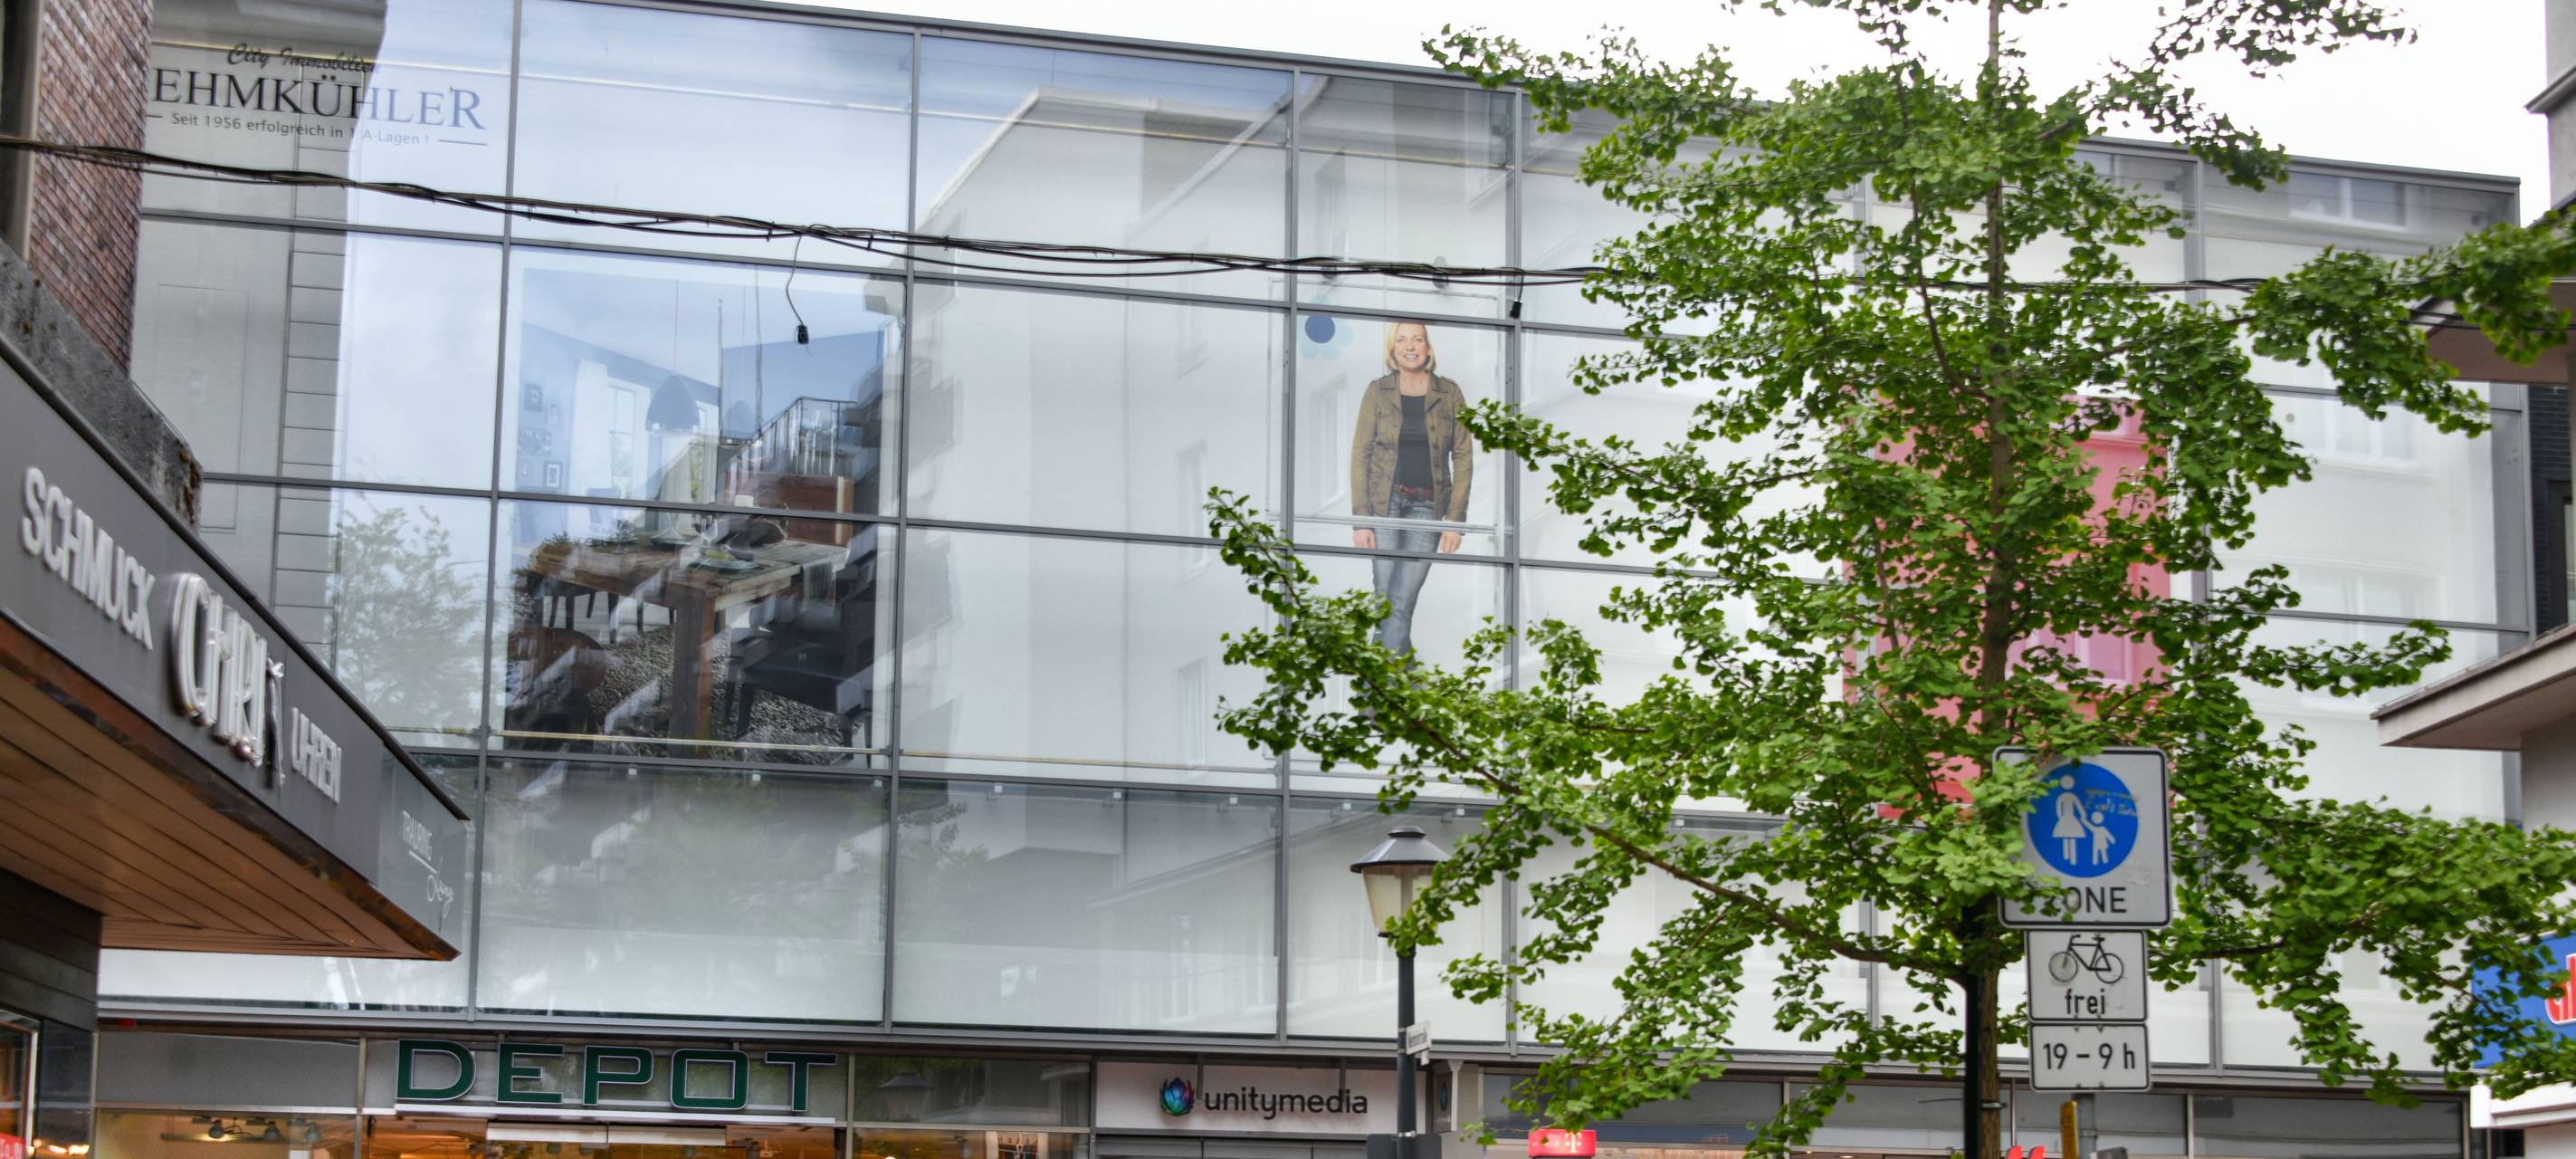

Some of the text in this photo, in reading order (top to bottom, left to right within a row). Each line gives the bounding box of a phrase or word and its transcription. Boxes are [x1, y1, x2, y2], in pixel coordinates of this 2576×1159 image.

[227, 43, 270, 69] City
[152, 66, 487, 130] EHMKÜHLER
[172, 112, 198, 127] Seit
[205, 115, 242, 129] 1956
[247, 120, 325, 137] erfolgreich
[330, 126, 343, 139] in
[22, 465, 156, 651] SCHMUCK
[291, 706, 342, 803] UHREN
[2041, 886, 2127, 915] ONE
[2065, 988, 2105, 1014] frei
[2043, 1043, 2067, 1069] 19
[2098, 1043, 2113, 1069] 9
[2123, 1042, 2135, 1069] h
[396, 1039, 837, 1112] DEPOT
[1205, 1087, 1368, 1120] unitymedia
